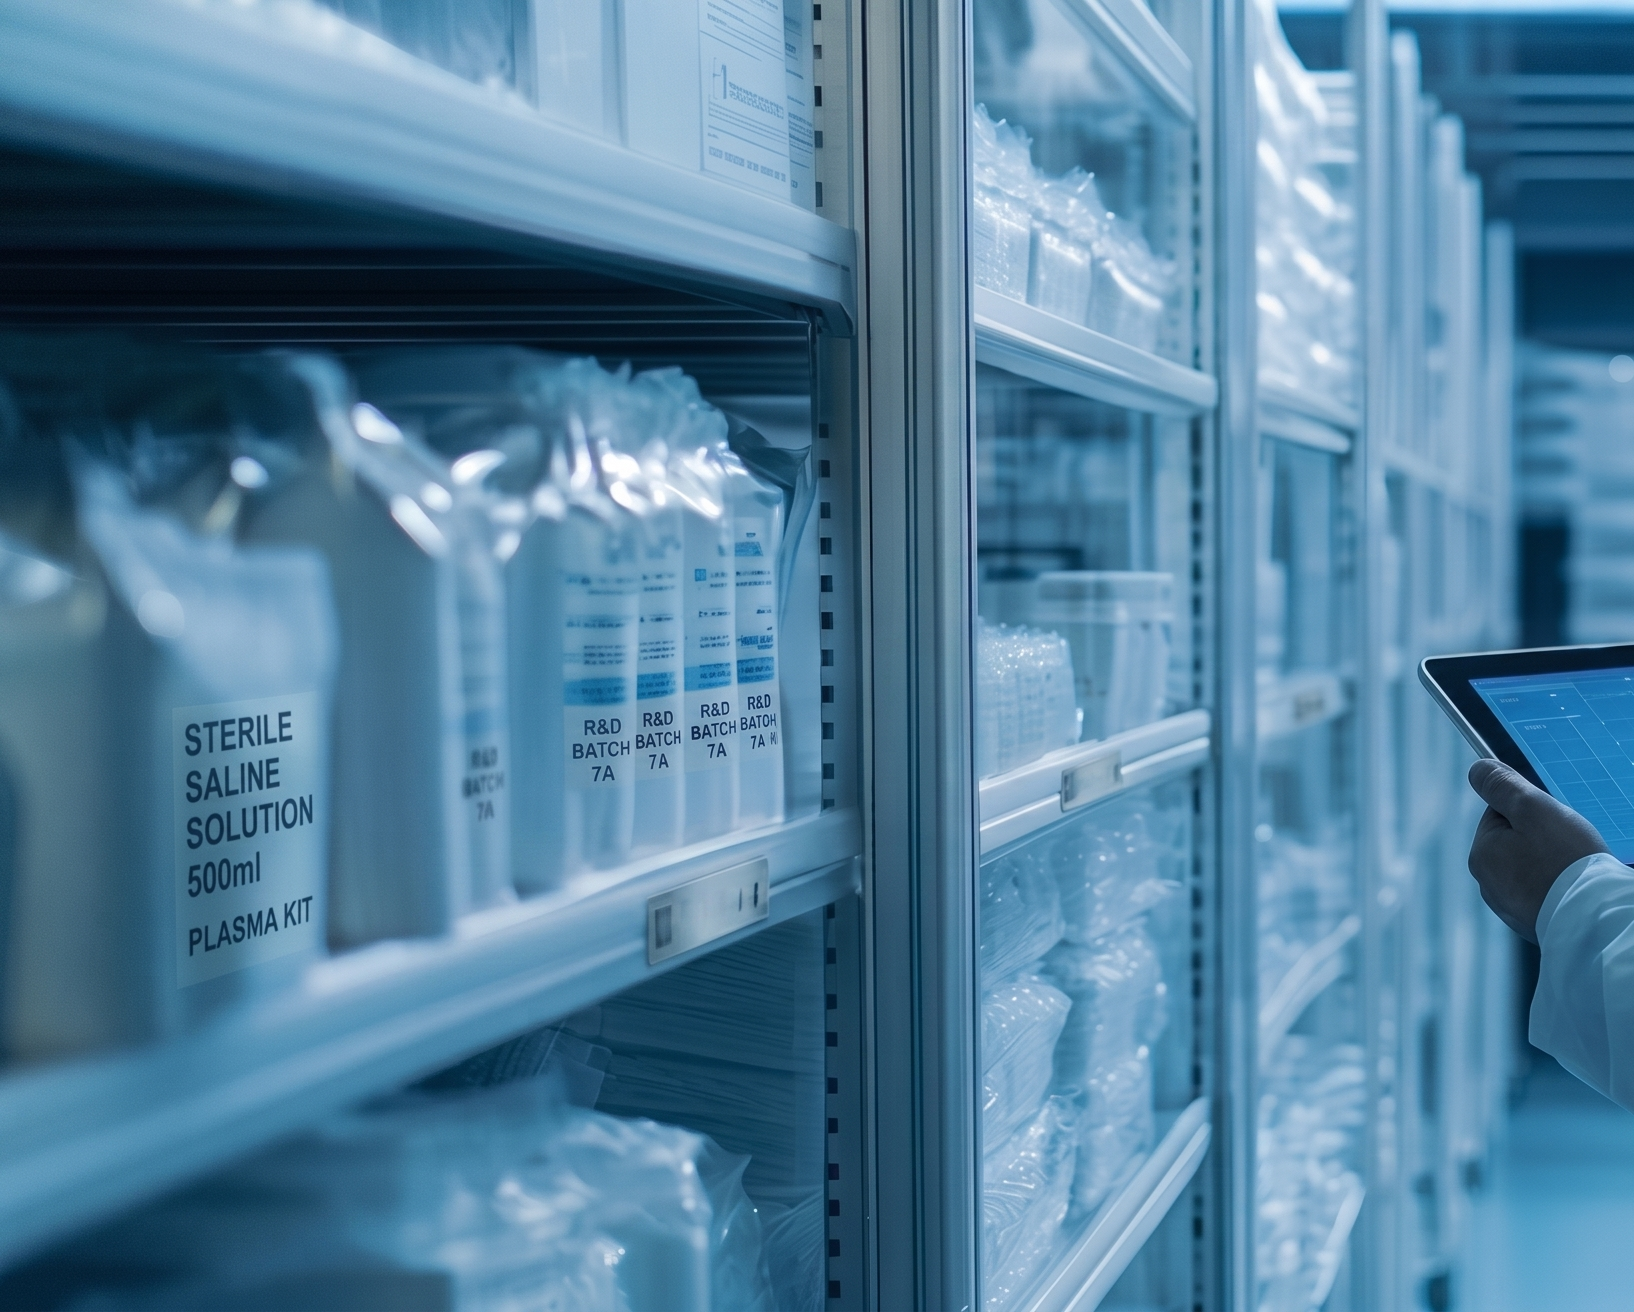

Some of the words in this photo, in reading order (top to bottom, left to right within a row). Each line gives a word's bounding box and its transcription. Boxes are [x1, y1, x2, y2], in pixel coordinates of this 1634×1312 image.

[700, 701, 730, 718] R&D
[747, 694, 771, 710] R&D
[584, 718, 622, 736] R&D
[643, 710, 673, 727] R&D
[185, 711, 293, 757] STERILE
[635, 730, 681, 749] BATCH
[690, 720, 737, 740] BATCH
[572, 740, 630, 759] BATCH
[707, 742, 727, 759] 7A
[649, 753, 669, 770] 7A
[186, 757, 280, 803] SALINE
[591, 765, 615, 782] 7A
[186, 794, 313, 849] SOLUTION
[187, 851, 260, 898] 500ml
[189, 907, 279, 957] PLASMA
[284, 895, 313, 929] KIT
